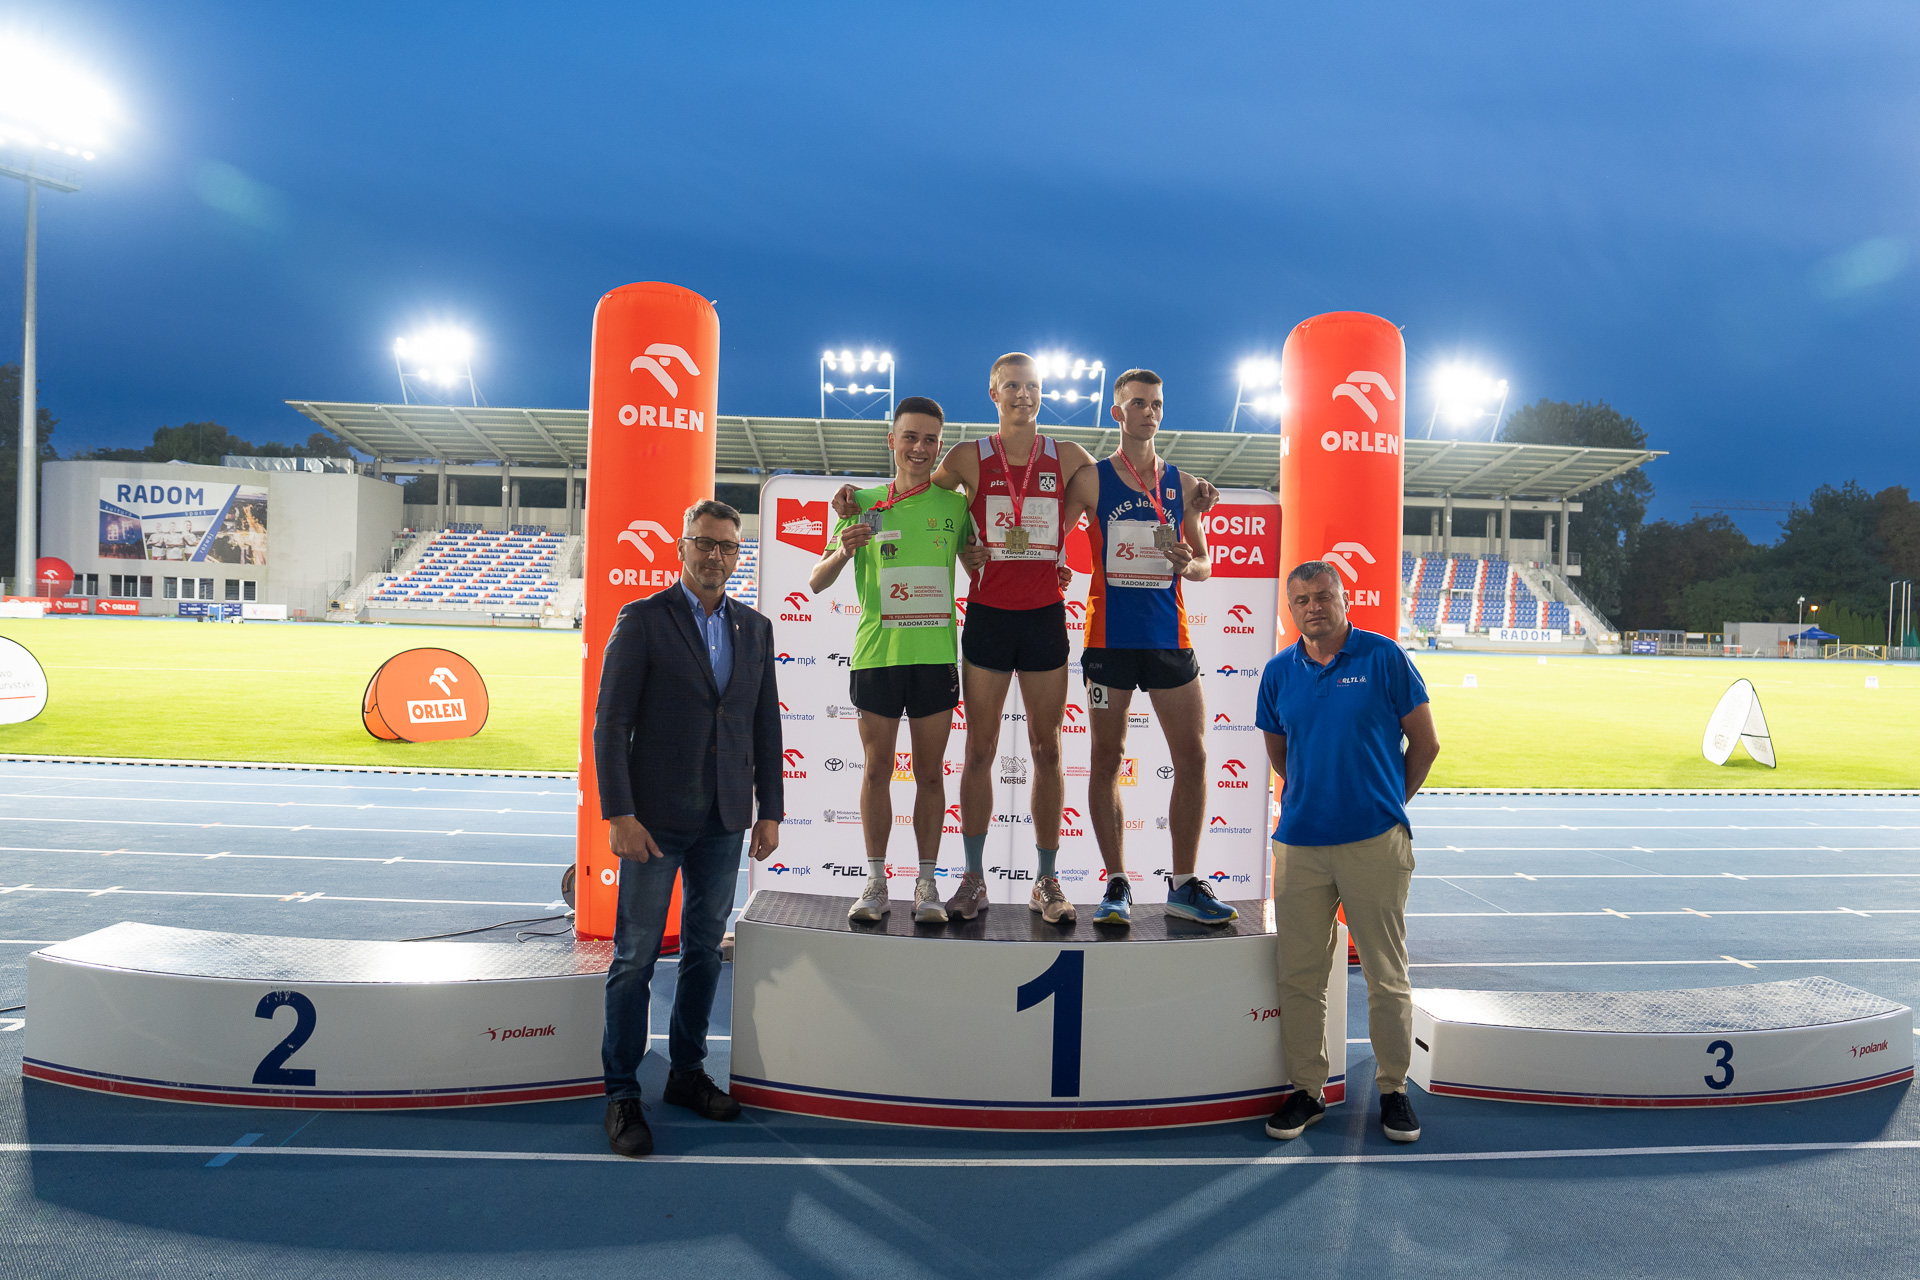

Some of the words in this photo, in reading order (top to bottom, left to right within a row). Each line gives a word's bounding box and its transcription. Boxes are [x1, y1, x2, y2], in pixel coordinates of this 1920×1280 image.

[618, 404, 705, 433] ORLEN
[1320, 430, 1399, 456] ORLEN
[117, 484, 204, 506] RADOM
[1116, 543, 1138, 560] 25.
[1208, 545, 1264, 565] IPCA
[609, 568, 679, 587] ORLEN
[890, 584, 913, 601] 25.
[780, 613, 812, 622] ORLEN
[1187, 613, 1208, 624] osir
[1066, 622, 1085, 630] RLE
[1223, 626, 1255, 634] ORLEN
[1500, 630, 1551, 641] RADOM
[797, 656, 816, 666] mpk
[1240, 668, 1259, 678] mpk
[0, 680, 34, 691] urystyki
[412, 702, 462, 719] ORLEN
[951, 722, 967, 730] RLE
[1062, 725, 1086, 734] RLEN
[943, 763, 955, 775] 5.
[1119, 777, 1136, 785] ZLA
[998, 814, 1021, 822] RLTL
[1125, 818, 1145, 829] osir
[1060, 829, 1083, 837] RLEN
[1209, 826, 1252, 834] administrator
[792, 866, 811, 876] mpk
[832, 866, 867, 877] FUEL
[885, 867, 896, 879] 5.
[999, 869, 1034, 880] FUEL
[1061, 868, 1090, 876] wodociągi
[1232, 873, 1251, 884] mpk
[1017, 950, 1085, 1098] 1
[252, 990, 317, 1087] 2
[501, 1024, 557, 1042] polanik
[1859, 1039, 1889, 1058] polanik
[1703, 1039, 1735, 1090] 3
